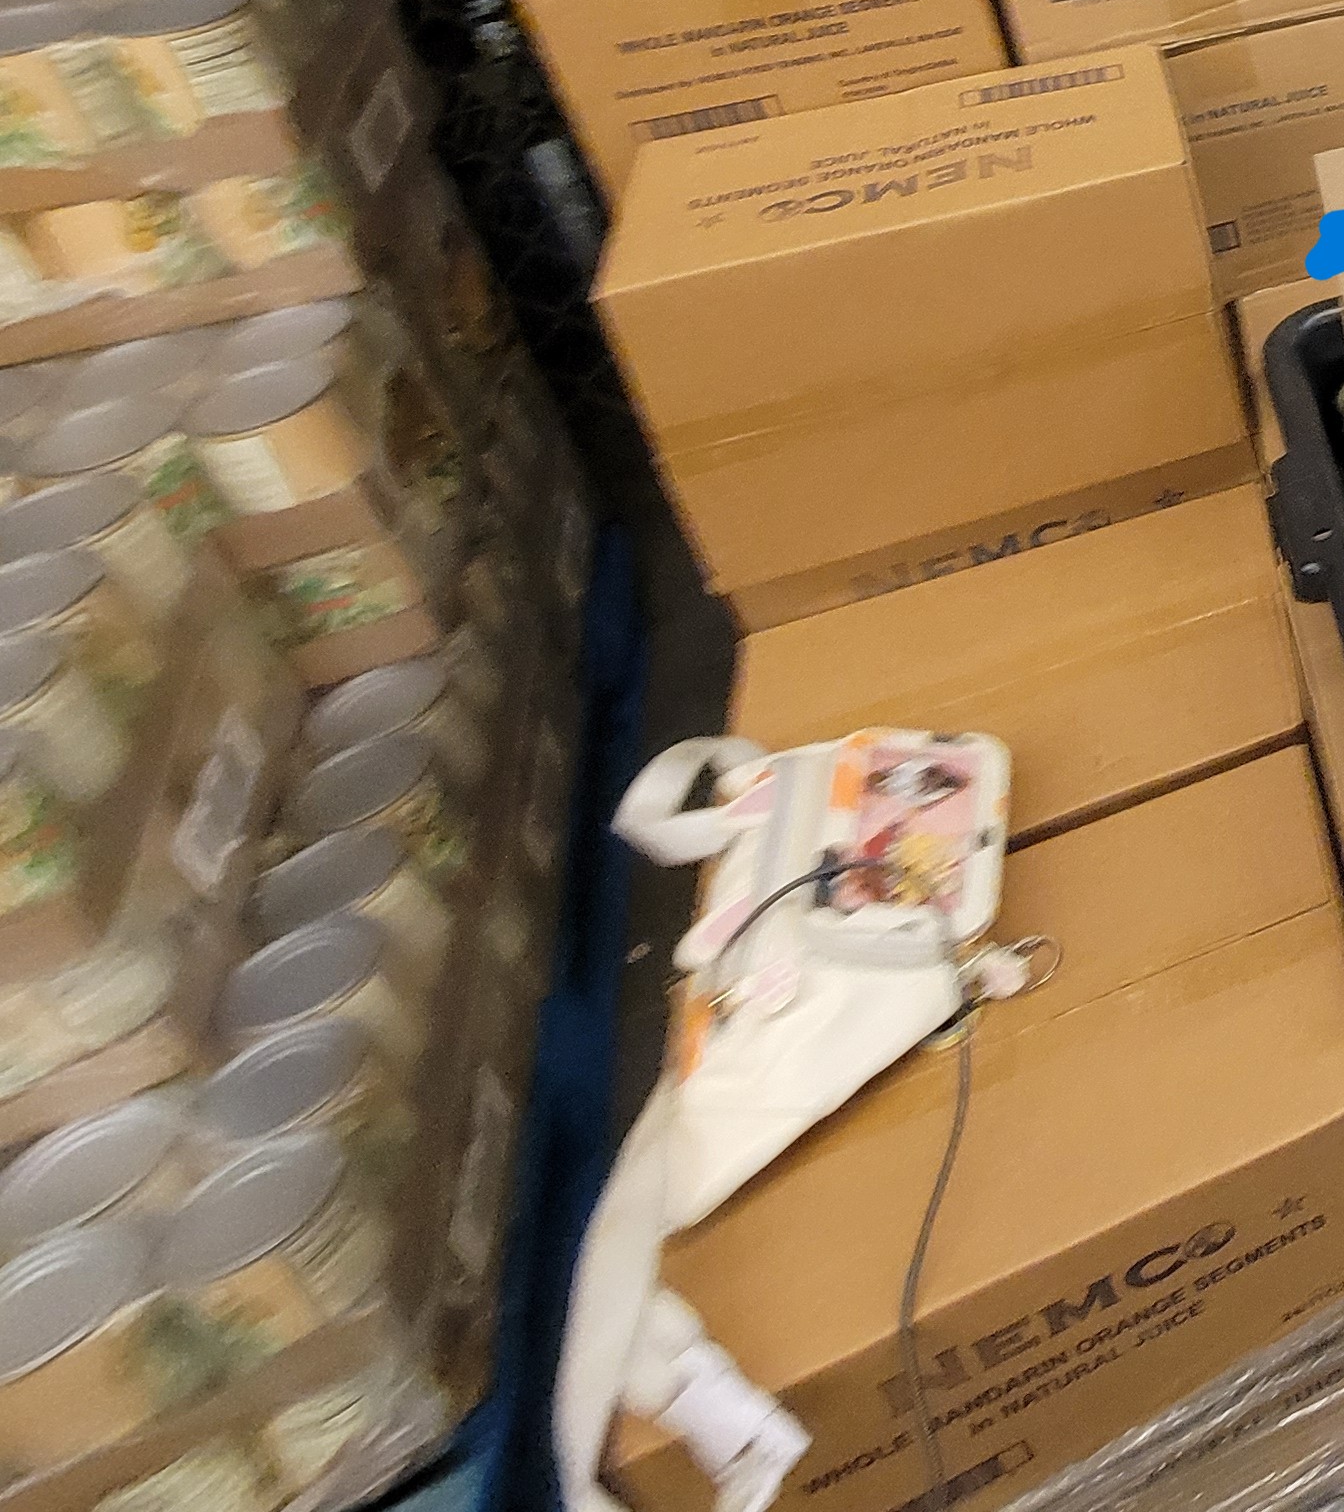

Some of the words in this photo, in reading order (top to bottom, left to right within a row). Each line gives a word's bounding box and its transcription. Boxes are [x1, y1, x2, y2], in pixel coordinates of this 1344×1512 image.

[1024, 114, 1097, 138] WHOLE
[1207, 97, 1284, 120] NATURAL
[879, 123, 967, 158] NATURAL
[809, 148, 870, 170] JUICE
[817, 156, 908, 183] ORANGE
[757, 145, 1033, 223] NEMCO
[878, 1221, 1236, 1418] NEMCO
[809, 1432, 911, 1495] WHOLE
[1075, 1288, 1186, 1354] ORANGE
[1192, 1214, 1328, 1293] SEGMENTS
[970, 1414, 996, 1438] in
[1002, 1346, 1125, 1418] NATURAL
[1134, 1300, 1206, 1348] JUICE
